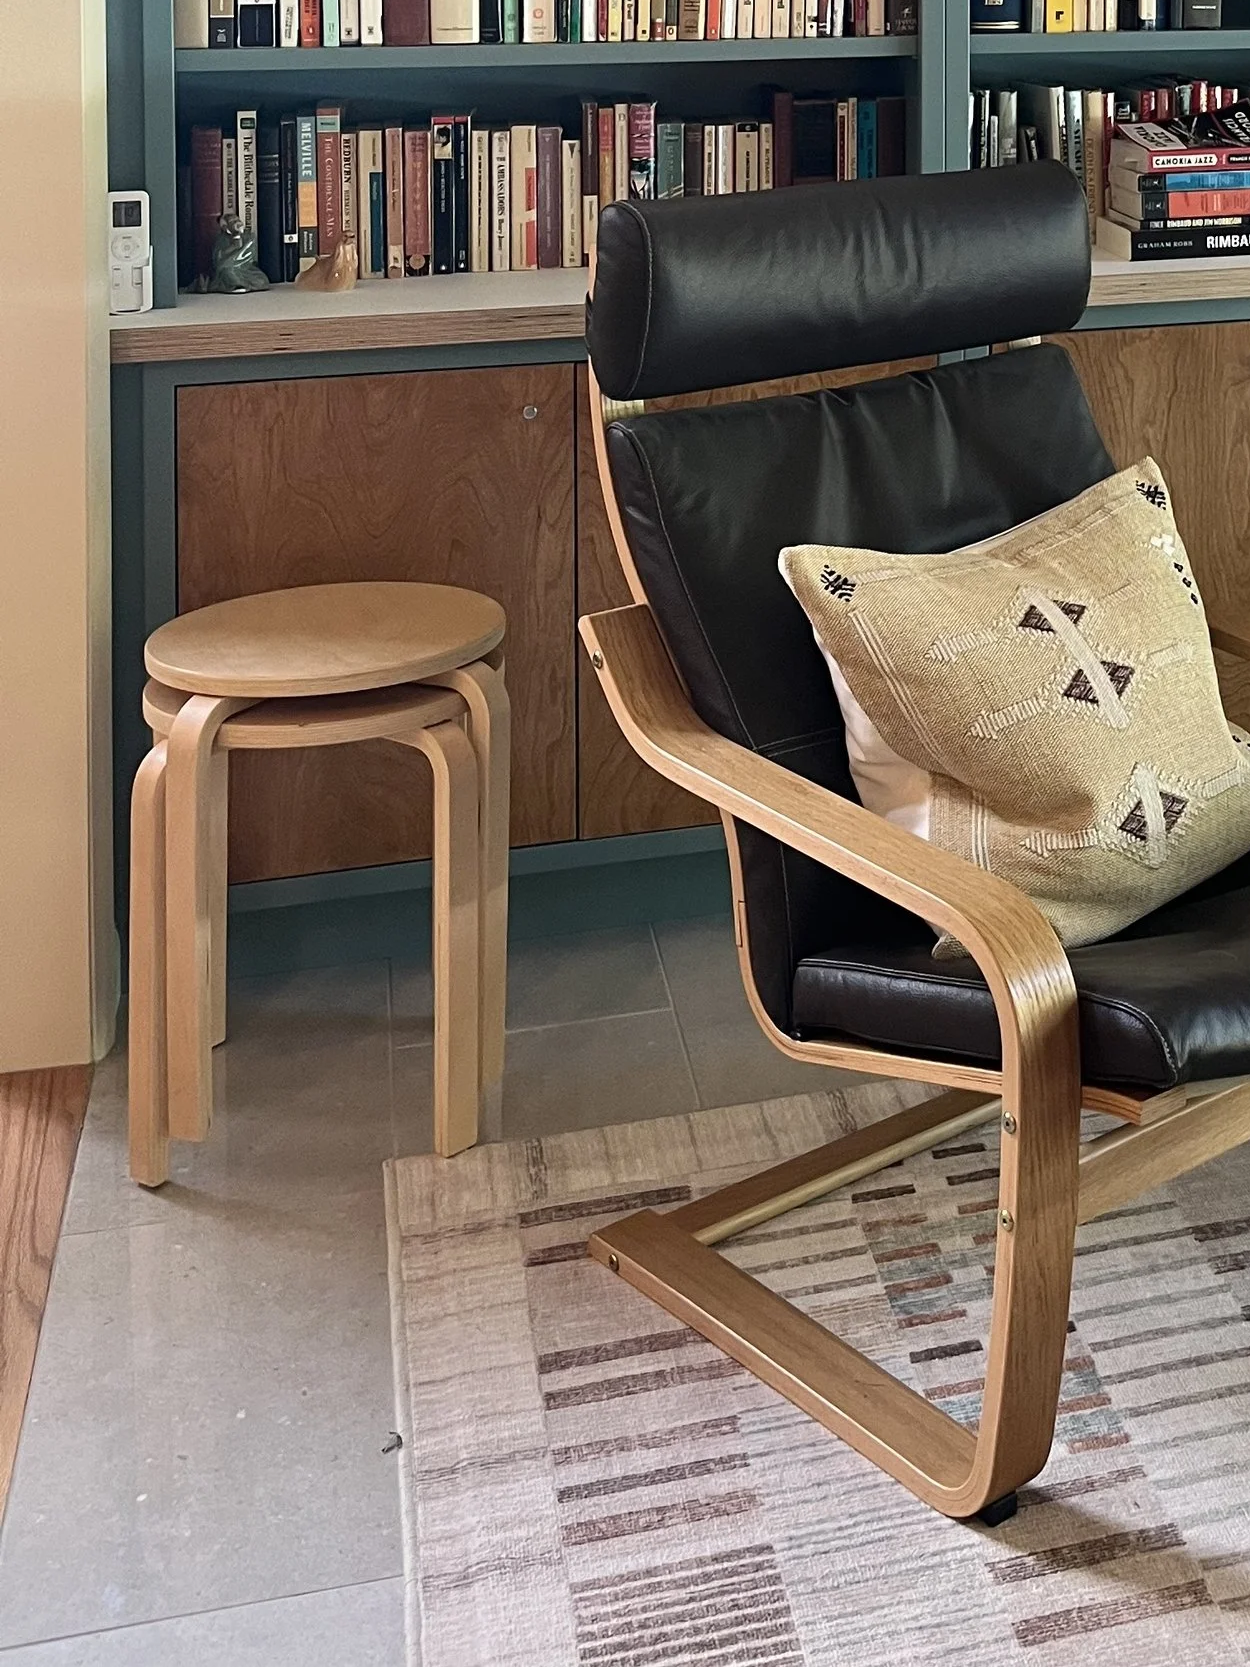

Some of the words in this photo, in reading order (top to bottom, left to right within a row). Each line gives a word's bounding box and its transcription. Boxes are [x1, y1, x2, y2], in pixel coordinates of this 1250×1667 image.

[242, 135, 253, 151] The
[300, 121, 312, 177] MELVILLE
[323, 136, 333, 154] THE
[1085, 137, 1095, 167] DEATH
[242, 153, 254, 198] Blithedale
[342, 137, 351, 184] REDBURN
[1086, 167, 1094, 175] IS
[1155, 157, 1192, 166] CAHOKIA
[1194, 156, 1214, 165] JAZZ
[323, 157, 335, 237] CONFIDENCE-MAN
[496, 163, 506, 216] AMBASSADORS
[1087, 182, 1096, 214] FRIEND
[1137, 241, 1172, 249] GRAHAM
